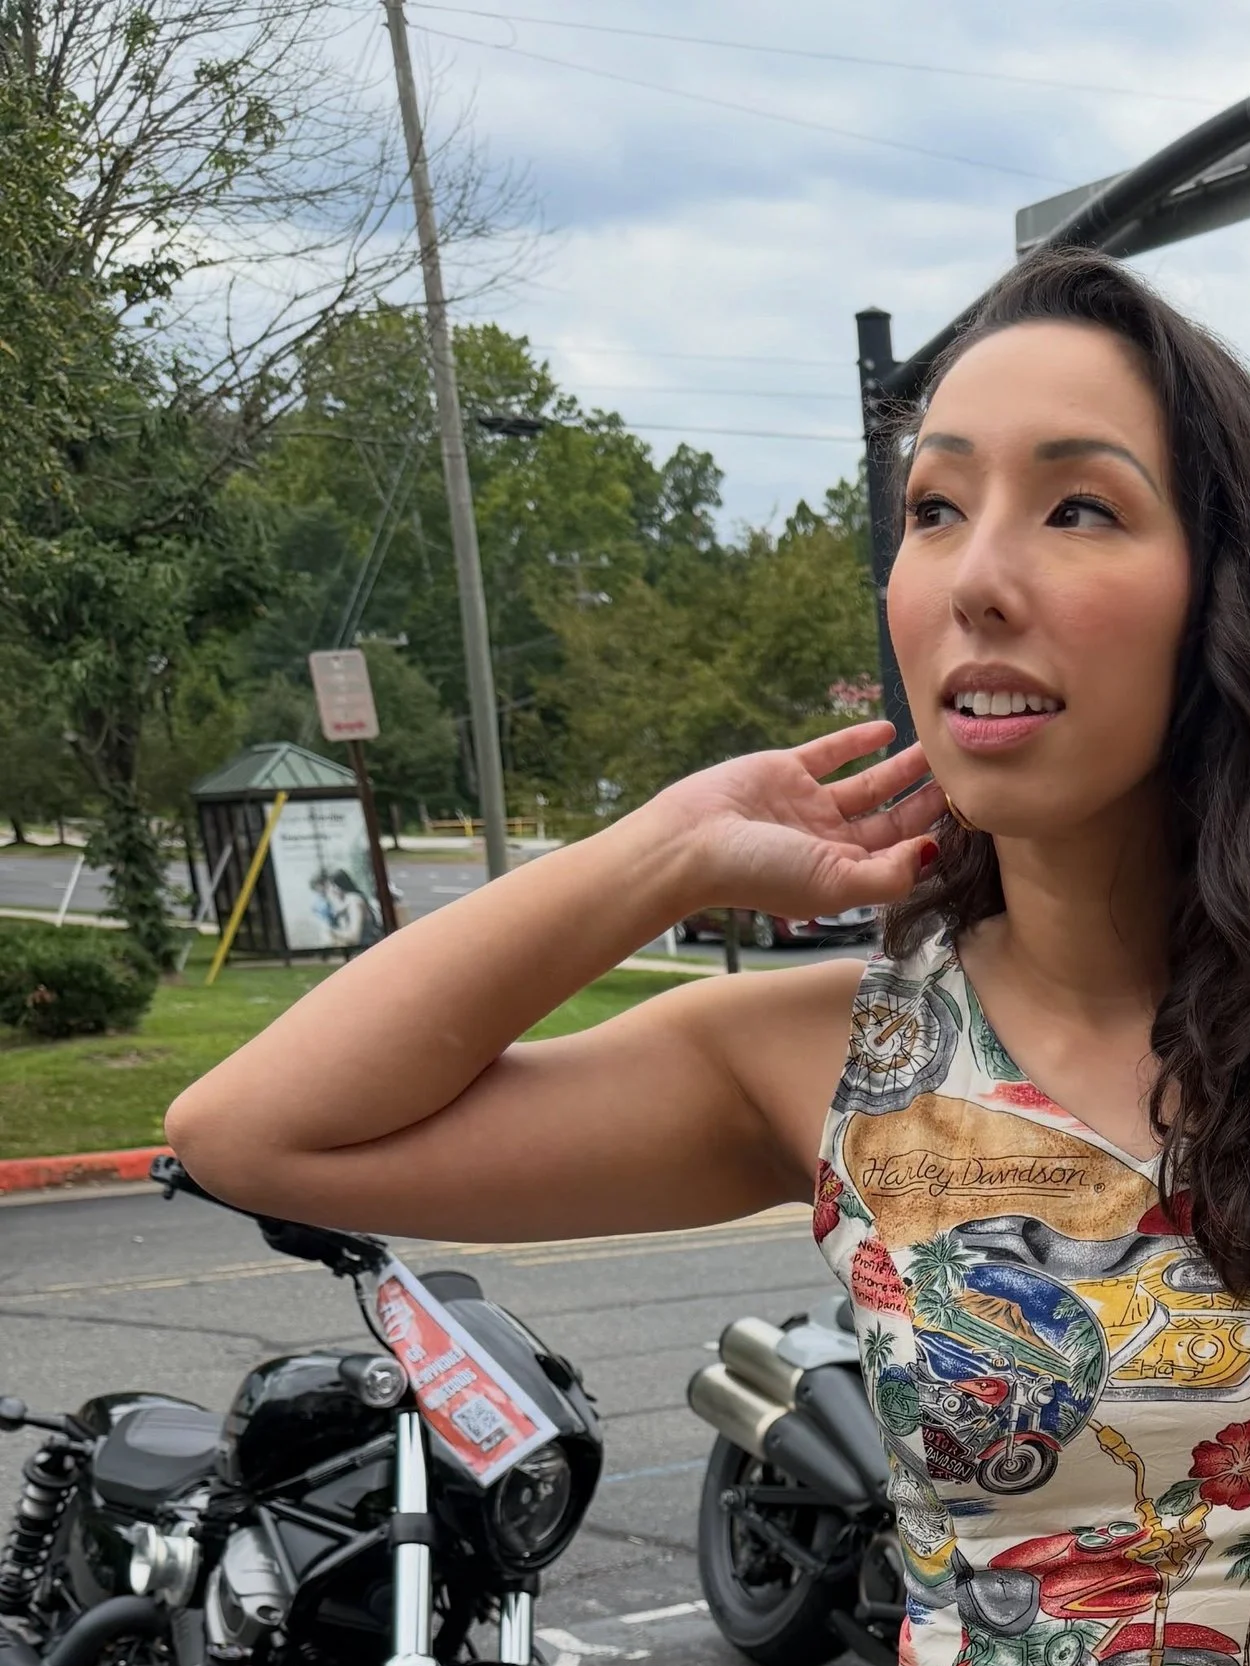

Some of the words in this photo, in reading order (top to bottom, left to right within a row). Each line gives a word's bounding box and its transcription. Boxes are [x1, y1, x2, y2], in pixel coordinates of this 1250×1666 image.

[863, 1153, 953, 1198] Harley
[962, 1157, 1093, 1187] Davidson
[926, 1446, 972, 1477] DAVIDSON
